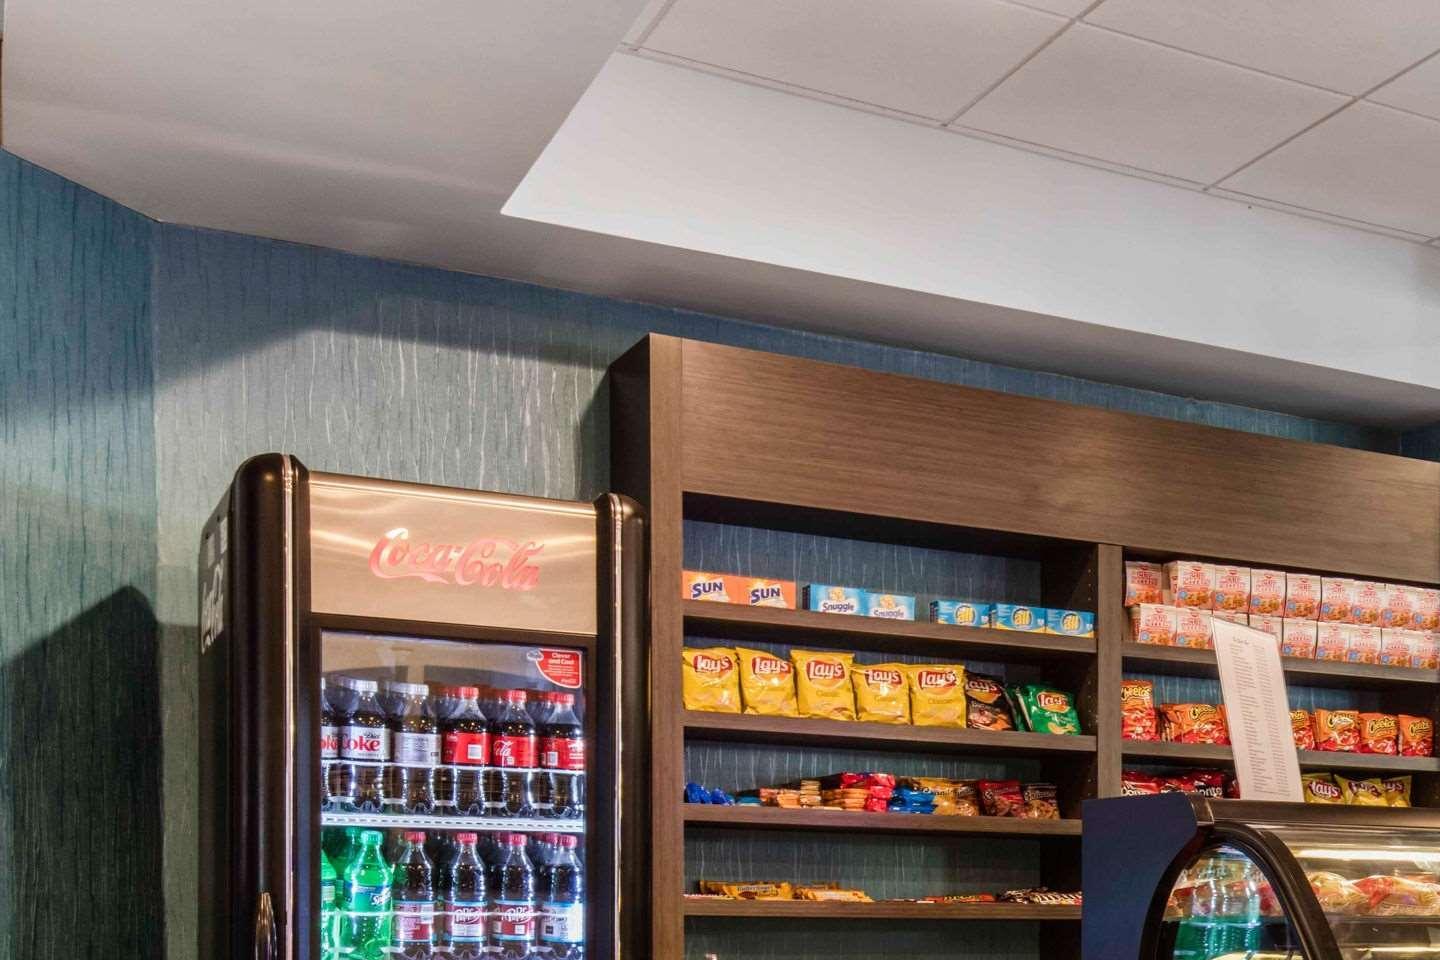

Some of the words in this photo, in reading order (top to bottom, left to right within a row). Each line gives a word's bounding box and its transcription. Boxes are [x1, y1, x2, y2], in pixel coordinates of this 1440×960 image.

[368, 527, 545, 592] Coca-Cola
[692, 582, 723, 598] SUN
[751, 588, 781, 604] SUN
[822, 602, 855, 612] Snuggle
